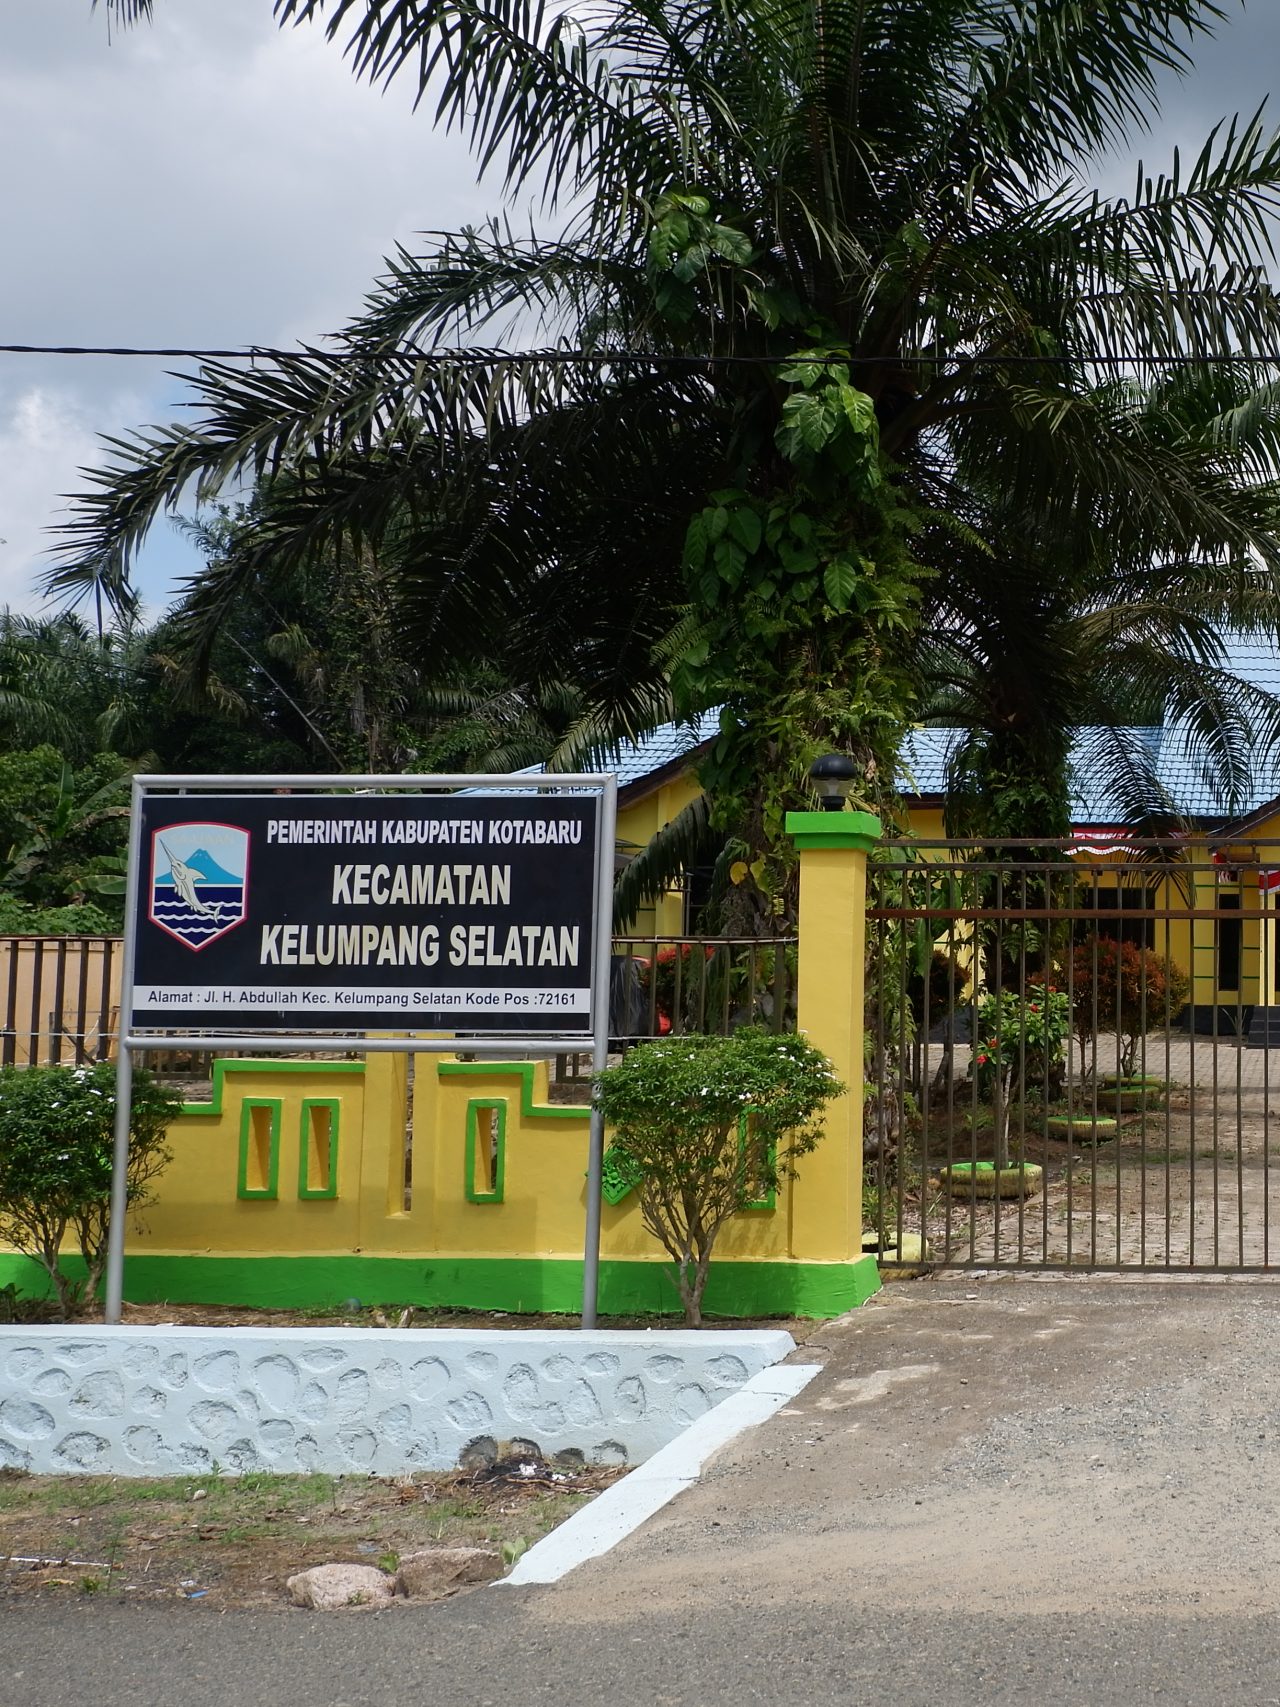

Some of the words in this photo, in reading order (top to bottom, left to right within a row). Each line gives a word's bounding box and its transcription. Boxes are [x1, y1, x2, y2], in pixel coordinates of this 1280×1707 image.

[267, 820, 377, 844] PEMERINTAH
[382, 820, 483, 844] KABUPATEN
[489, 820, 582, 844] KOTABARU
[332, 864, 511, 905] KECAMATAN
[260, 925, 439, 966] KELUMPANG
[449, 925, 580, 966] SELATAN
[148, 990, 193, 1003] Alamat
[204, 990, 219, 1003] Jl.
[222, 990, 236, 1003] H.
[239, 990, 298, 1004] Abdullah
[302, 991, 330, 1004] Kec.
[334, 991, 409, 1007] Kelumpang
[412, 991, 462, 1005] Selatan
[466, 992, 500, 1005] Kode
[504, 992, 530, 1005] Pos
